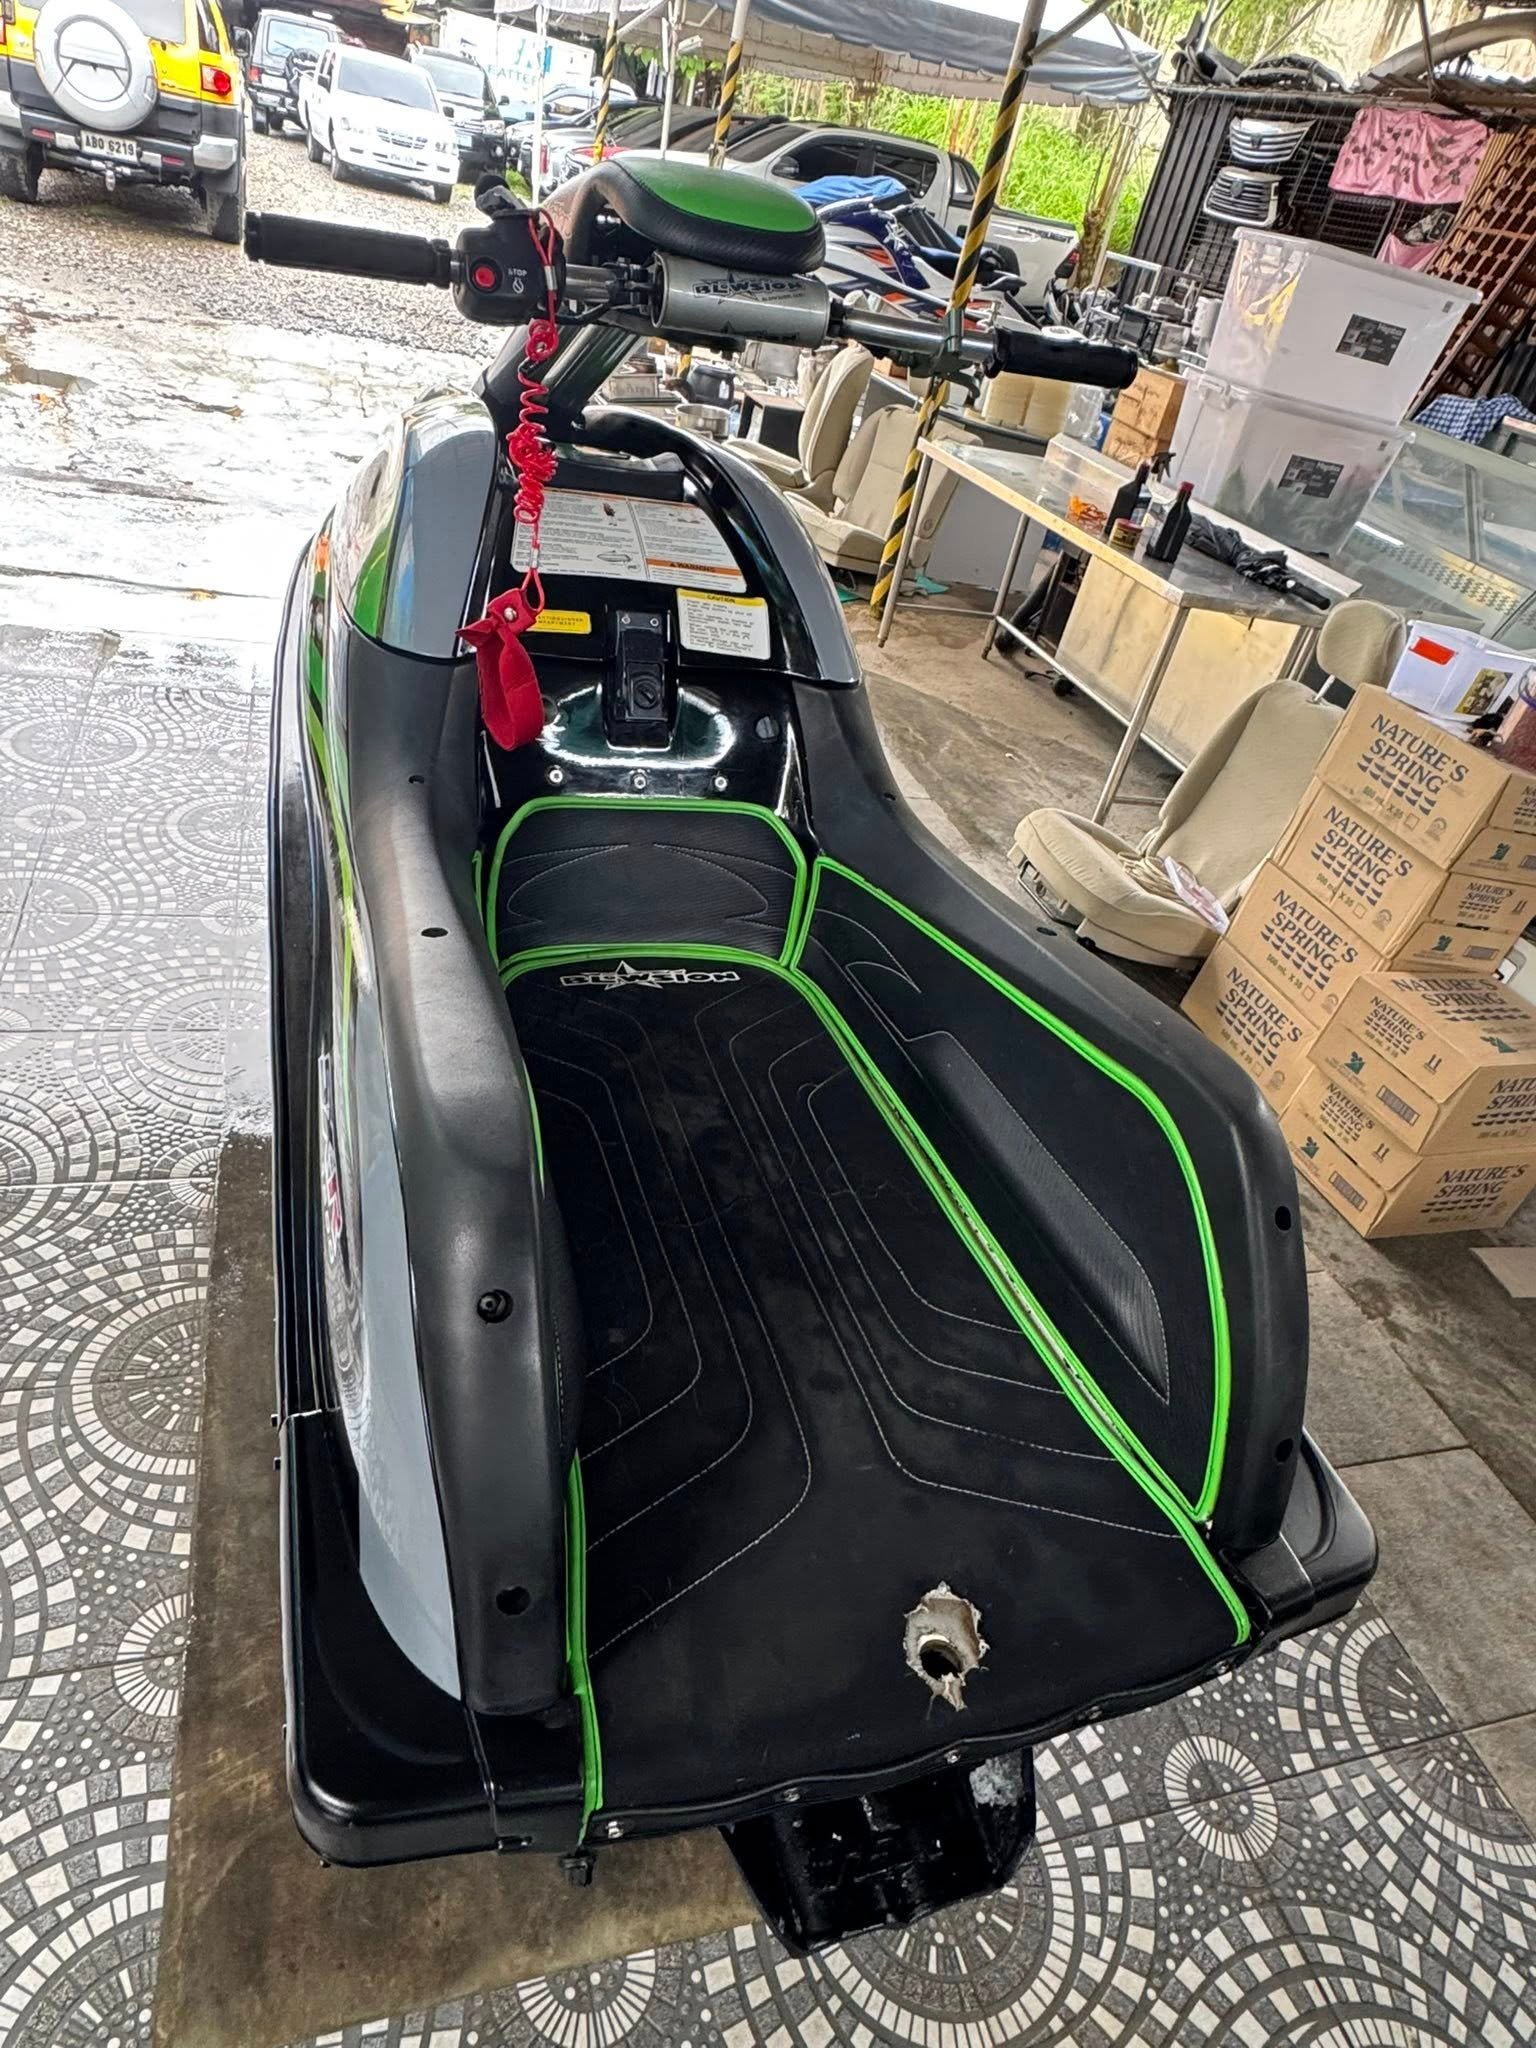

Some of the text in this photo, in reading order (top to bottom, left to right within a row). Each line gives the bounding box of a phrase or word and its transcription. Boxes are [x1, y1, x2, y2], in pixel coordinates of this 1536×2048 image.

[108, 140, 134, 156] 6219
[507, 267, 528, 277] STOP
[1370, 738, 1445, 795] SPRING
[1371, 714, 1469, 782] NATURE'S
[1322, 829, 1391, 886] SPRING
[1324, 806, 1413, 877] NATURE'S
[1467, 882, 1517, 897] NATURE'S
[1271, 912, 1339, 971] SPRING
[1273, 889, 1358, 963] NATURE'S
[1226, 967, 1302, 1042] NATURE'S
[1391, 979, 1498, 991] NATURE'S
[1421, 992, 1507, 1007] SPRING
[1225, 988, 1285, 1048] SPRING
[1370, 996, 1426, 1041] NATURE'S
[1370, 1008, 1414, 1045] SPRING
[1326, 1083, 1375, 1129] NATURE'S
[1327, 1095, 1364, 1132] SPRING
[1434, 1181, 1508, 1198] SPRING
[1436, 1164, 1530, 1184] NATURE'S
